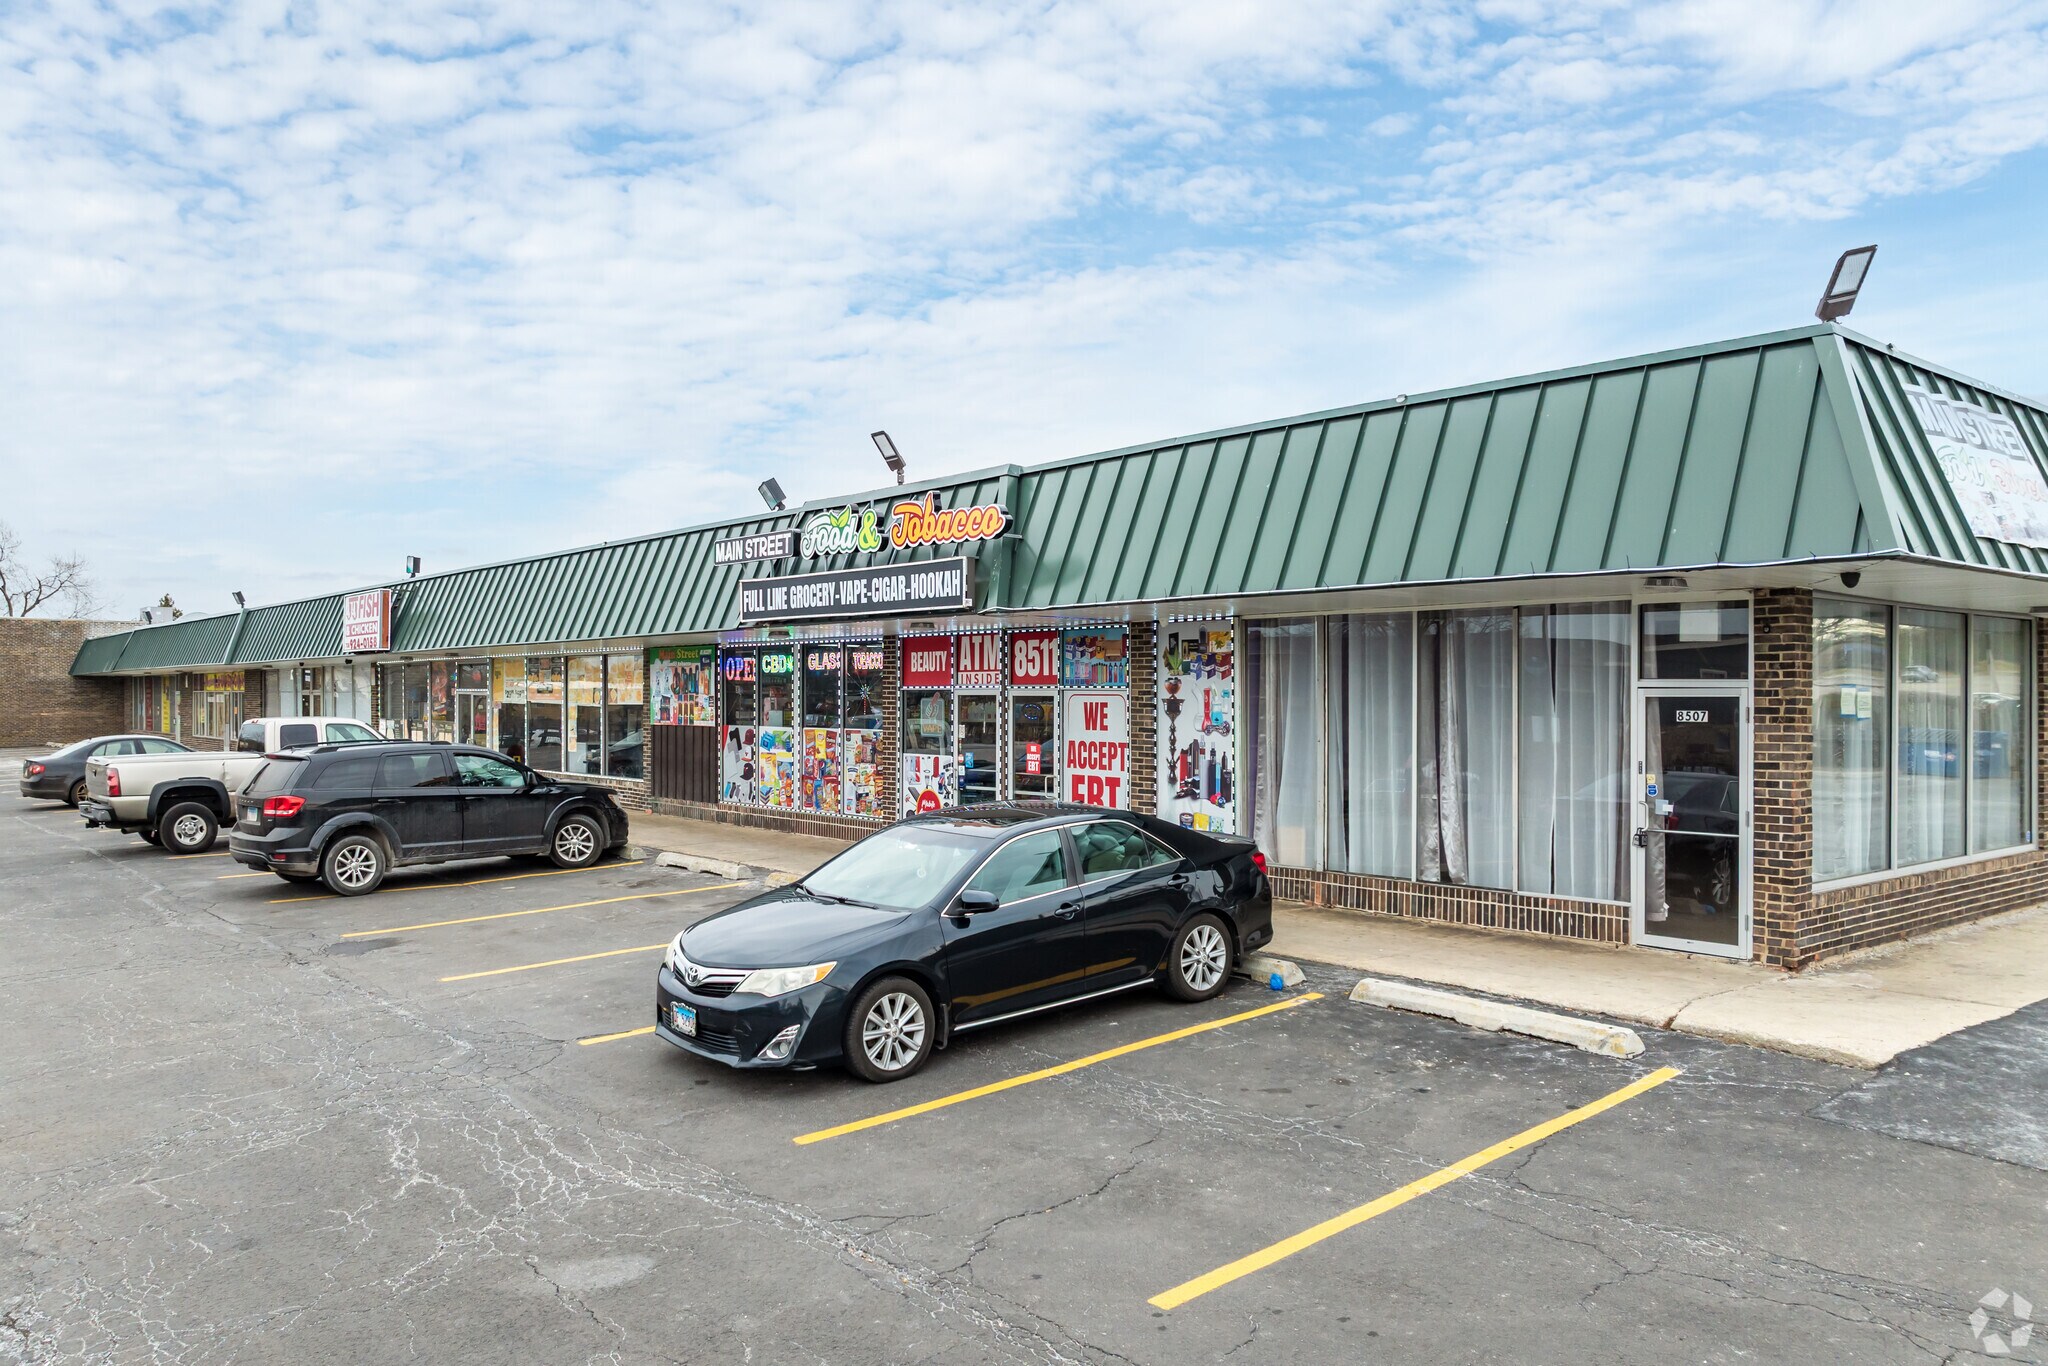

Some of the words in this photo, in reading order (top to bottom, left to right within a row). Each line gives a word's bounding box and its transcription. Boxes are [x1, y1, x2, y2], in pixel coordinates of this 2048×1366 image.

[715, 540, 743, 563] MAIN
[745, 533, 792, 558] STREET
[801, 505, 858, 560] Food
[858, 508, 881, 552] &
[891, 491, 1005, 549] Tobacco
[359, 593, 379, 619] FISH
[743, 590, 764, 613] FULL
[767, 587, 788, 611] LINE
[351, 622, 378, 635] CHICKEN
[676, 648, 699, 659] Street
[852, 652, 884, 670] TOBACCO
[911, 651, 947, 673] BEAUTY
[960, 634, 1000, 670] ATM
[1014, 638, 1058, 677] 8511
[762, 654, 786, 673] CBD
[961, 673, 999, 684] INSIDE
[1083, 701, 1108, 731] WE
[1677, 711, 1707, 722] 8507
[1028, 761, 1039, 771] EBT
[1067, 740, 1127, 771] ACCEPT
